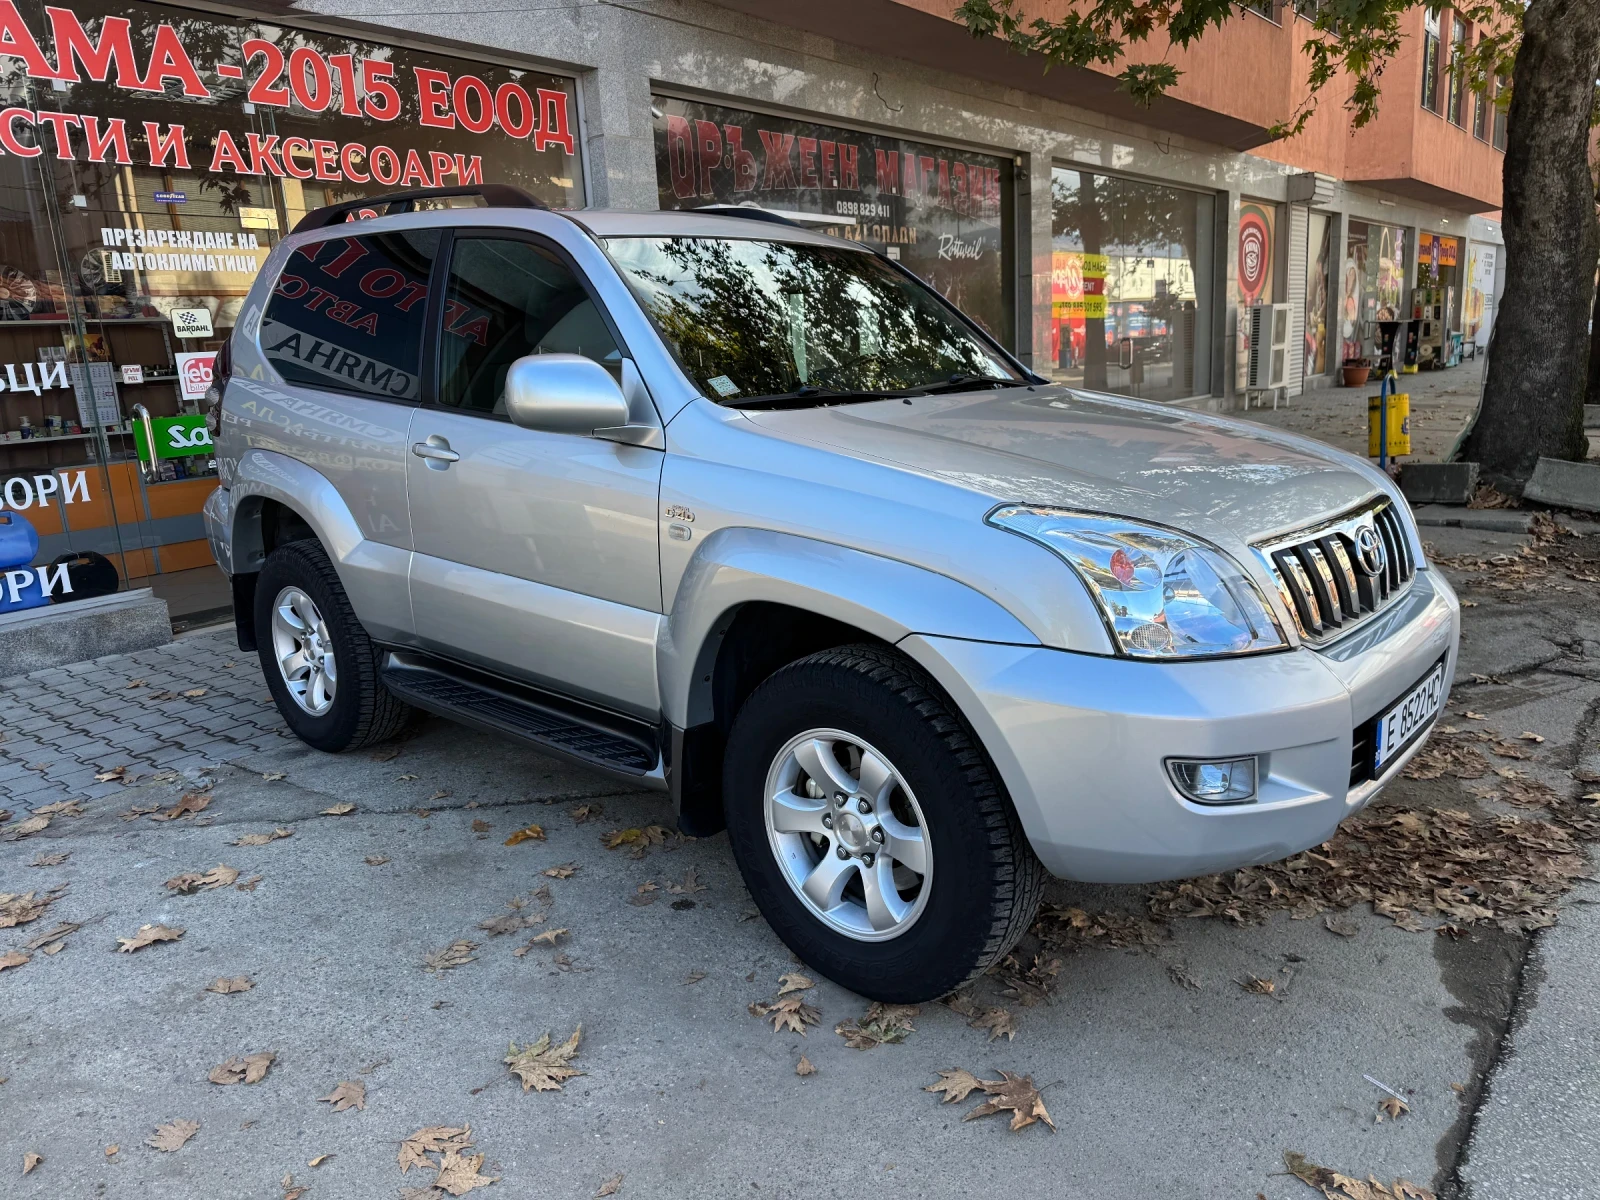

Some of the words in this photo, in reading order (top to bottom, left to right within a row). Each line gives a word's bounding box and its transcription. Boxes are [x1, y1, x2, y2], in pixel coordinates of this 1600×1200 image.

[413, 66, 575, 156] ЕООД
[0, 107, 131, 164] СТИ
[143, 121, 192, 170] И
[209, 129, 484, 188] АКСЕСОАРИ
[666, 114, 860, 199] ОРЪЖЕЕН
[874, 148, 1001, 219] МАГАЗИН
[836, 200, 859, 215] 0898
[859, 203, 876, 216] 829
[877, 205, 890, 217] 411
[101, 228, 235, 249] ПРЕЗАРЕЖДАНЕ
[237, 231, 259, 250] НА
[938, 232, 985, 261] Rottweil
[111, 252, 257, 274] АВТОКЛИМАТИЦИ
[177, 325, 210, 333] BARDAHL
[0, 361, 70, 396] ЦИ
[183, 359, 213, 384] feb
[0, 471, 91, 510] ОРИ
[0, 563, 74, 604] РИ
